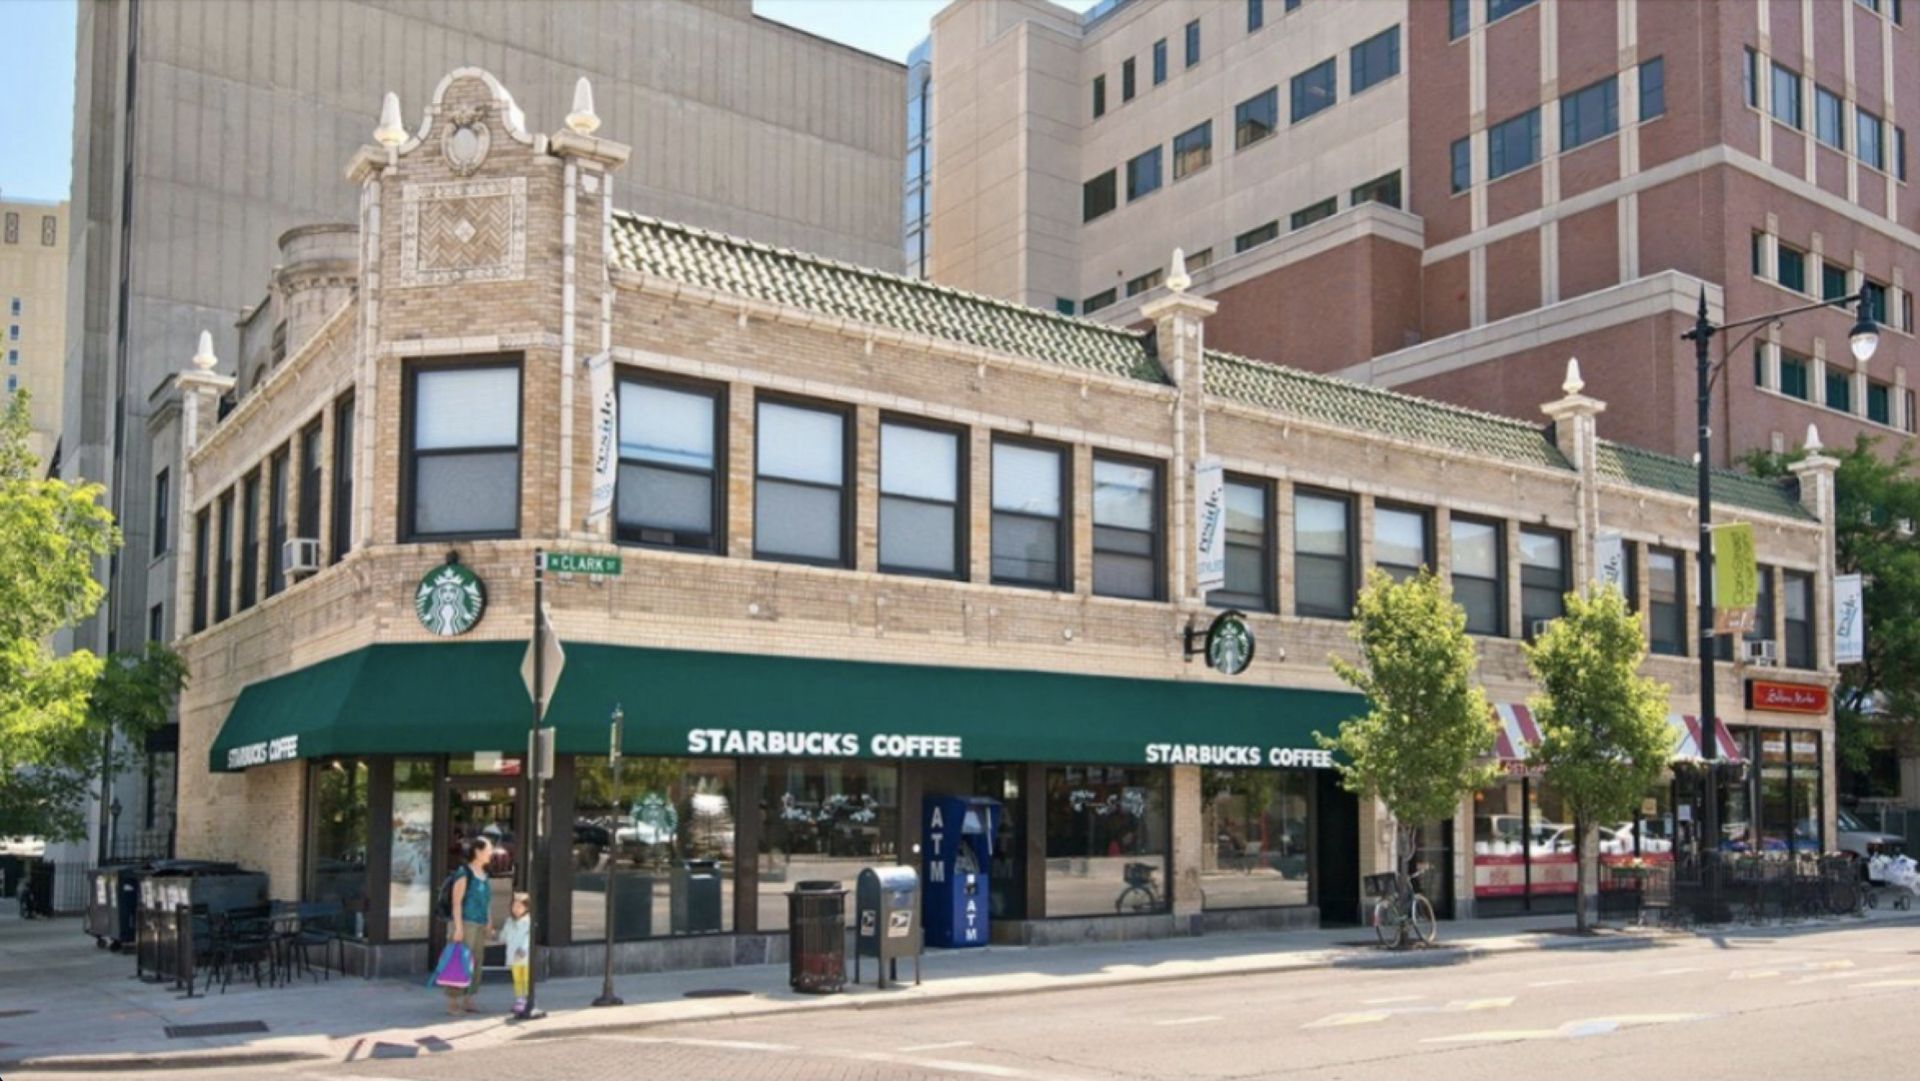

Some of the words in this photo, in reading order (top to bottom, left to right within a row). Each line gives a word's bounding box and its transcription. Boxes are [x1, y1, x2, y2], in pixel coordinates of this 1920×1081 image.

[560, 555, 604, 571] CLARK
[228, 741, 267, 769] STARBUCKS
[269, 734, 298, 762] COFFEE
[688, 729, 860, 755] STARBUCKS
[871, 734, 962, 757] COFFEE
[1145, 743, 1261, 765] STARBUCKS
[1269, 748, 1332, 767] COFFEE
[931, 806, 945, 882] ATM
[965, 899, 977, 941] ATM
